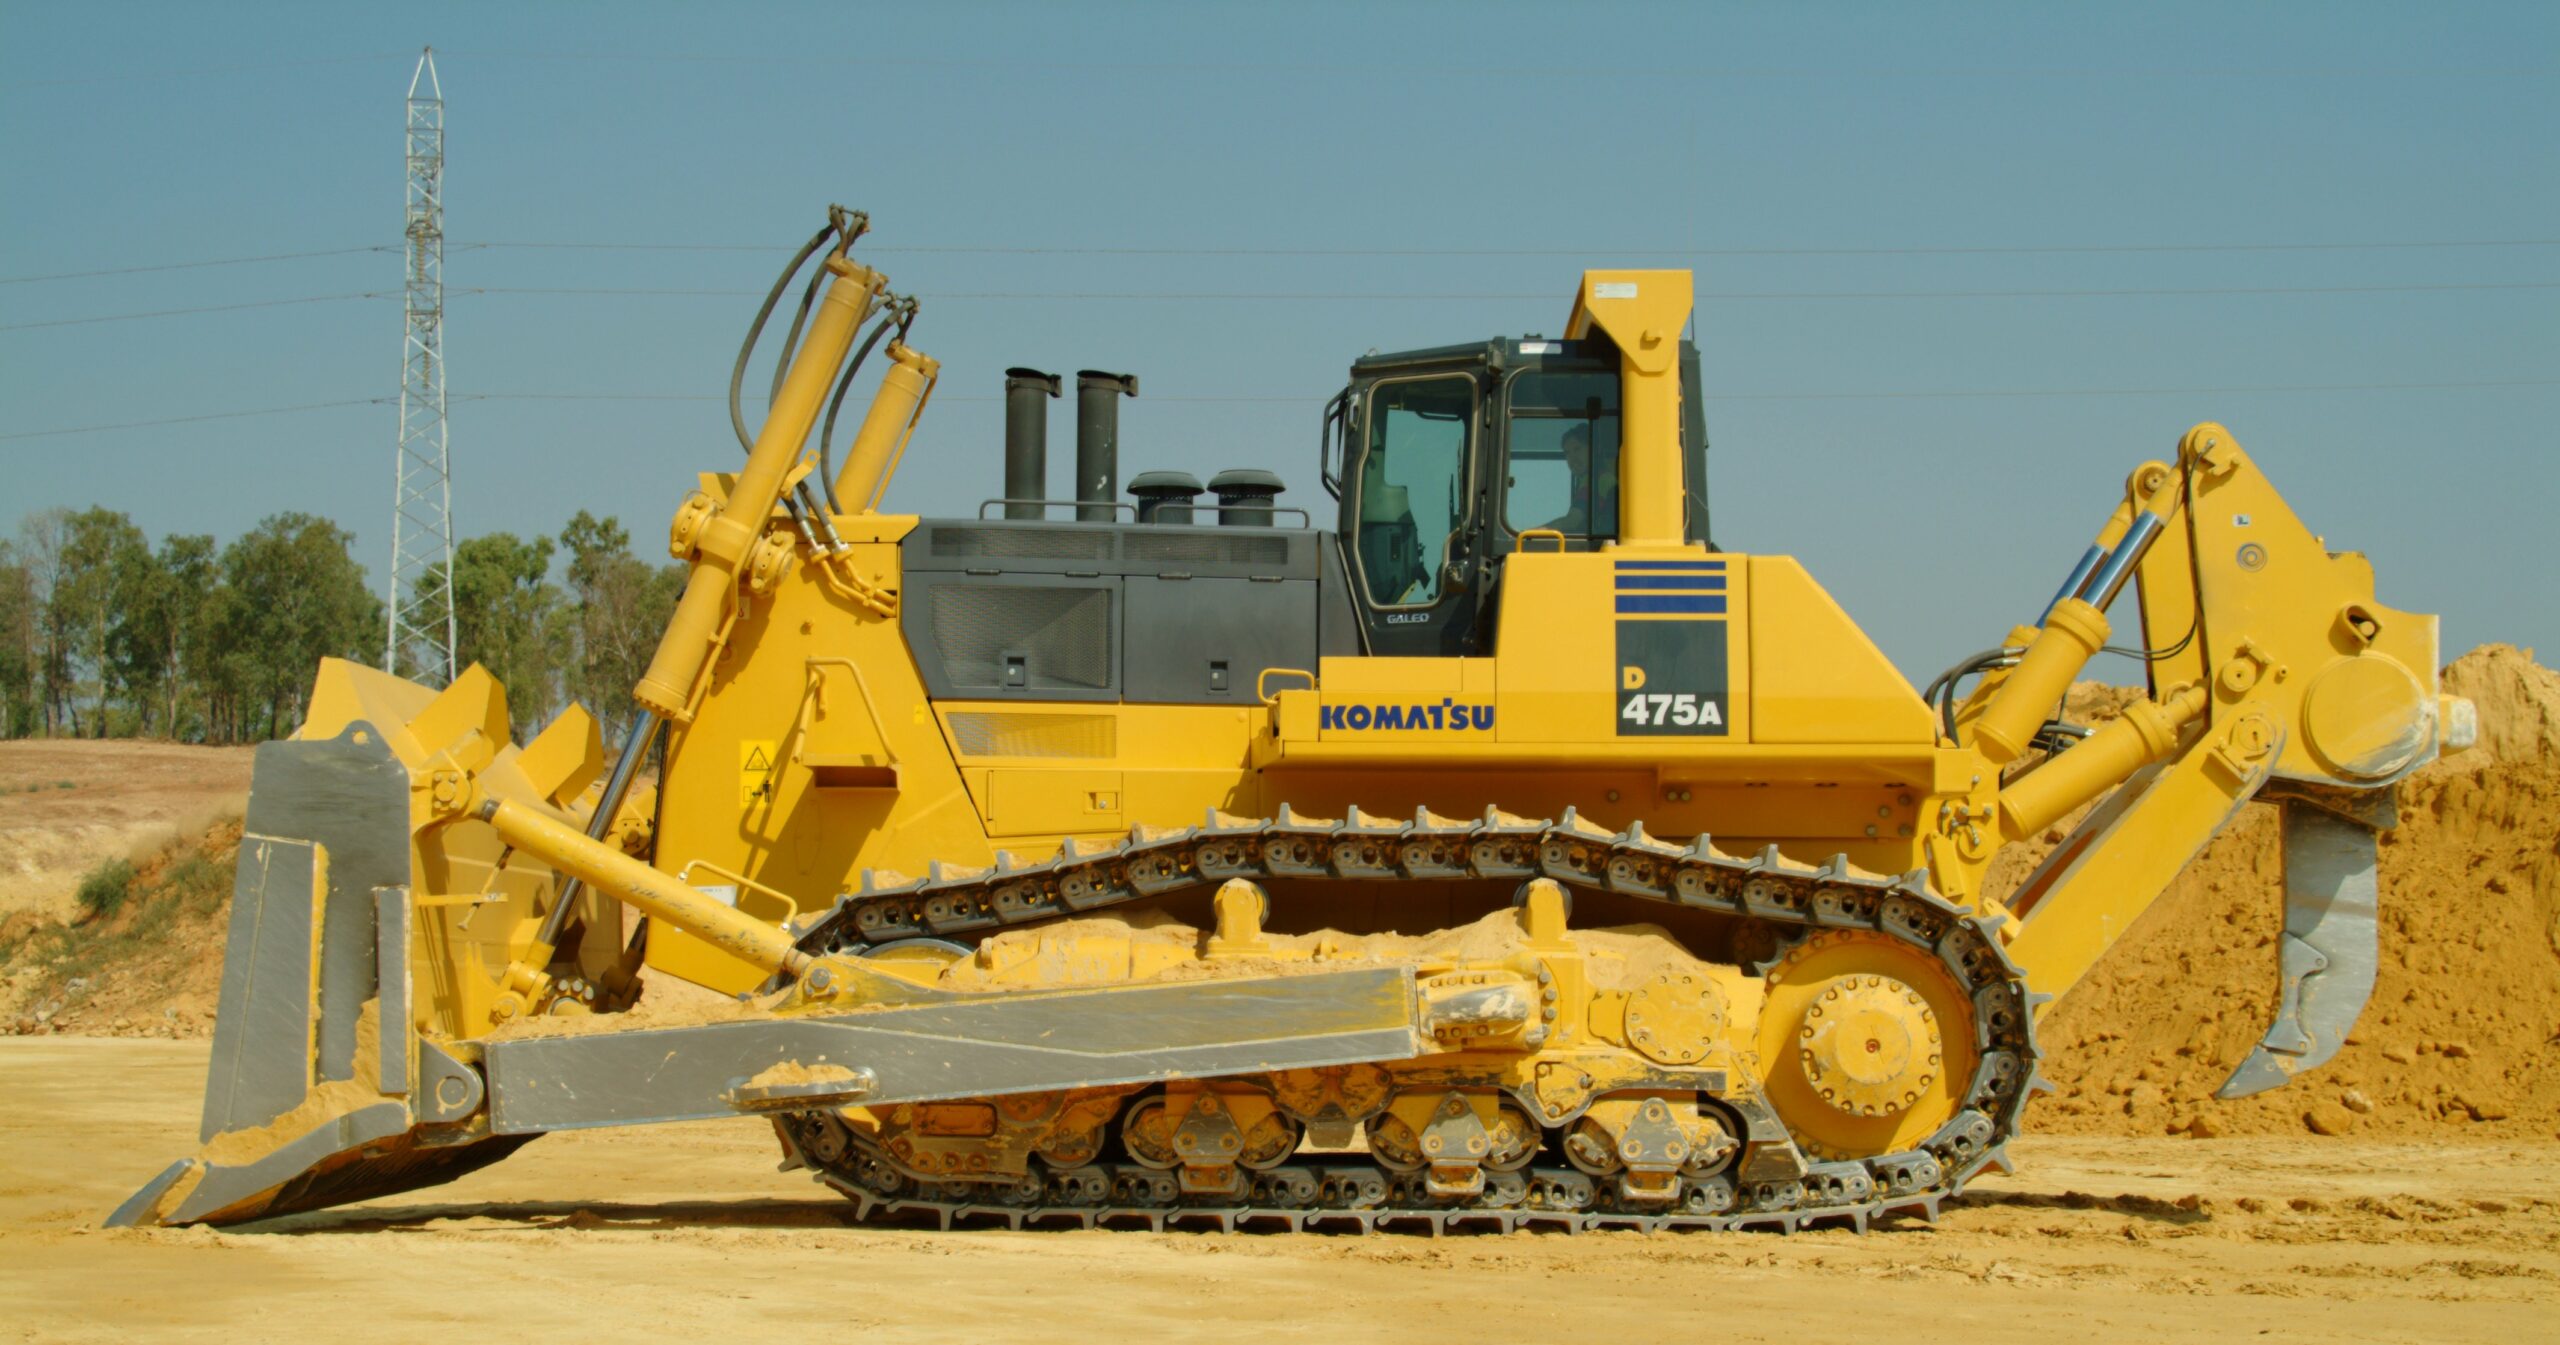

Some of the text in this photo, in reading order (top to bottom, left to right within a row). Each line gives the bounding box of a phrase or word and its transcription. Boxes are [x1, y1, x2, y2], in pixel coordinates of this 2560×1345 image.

[1387, 613, 1430, 624] GALEO
[1623, 666, 1646, 690] D
[1320, 698, 1495, 730] KOMATSU
[1622, 694, 1723, 726] 475A
